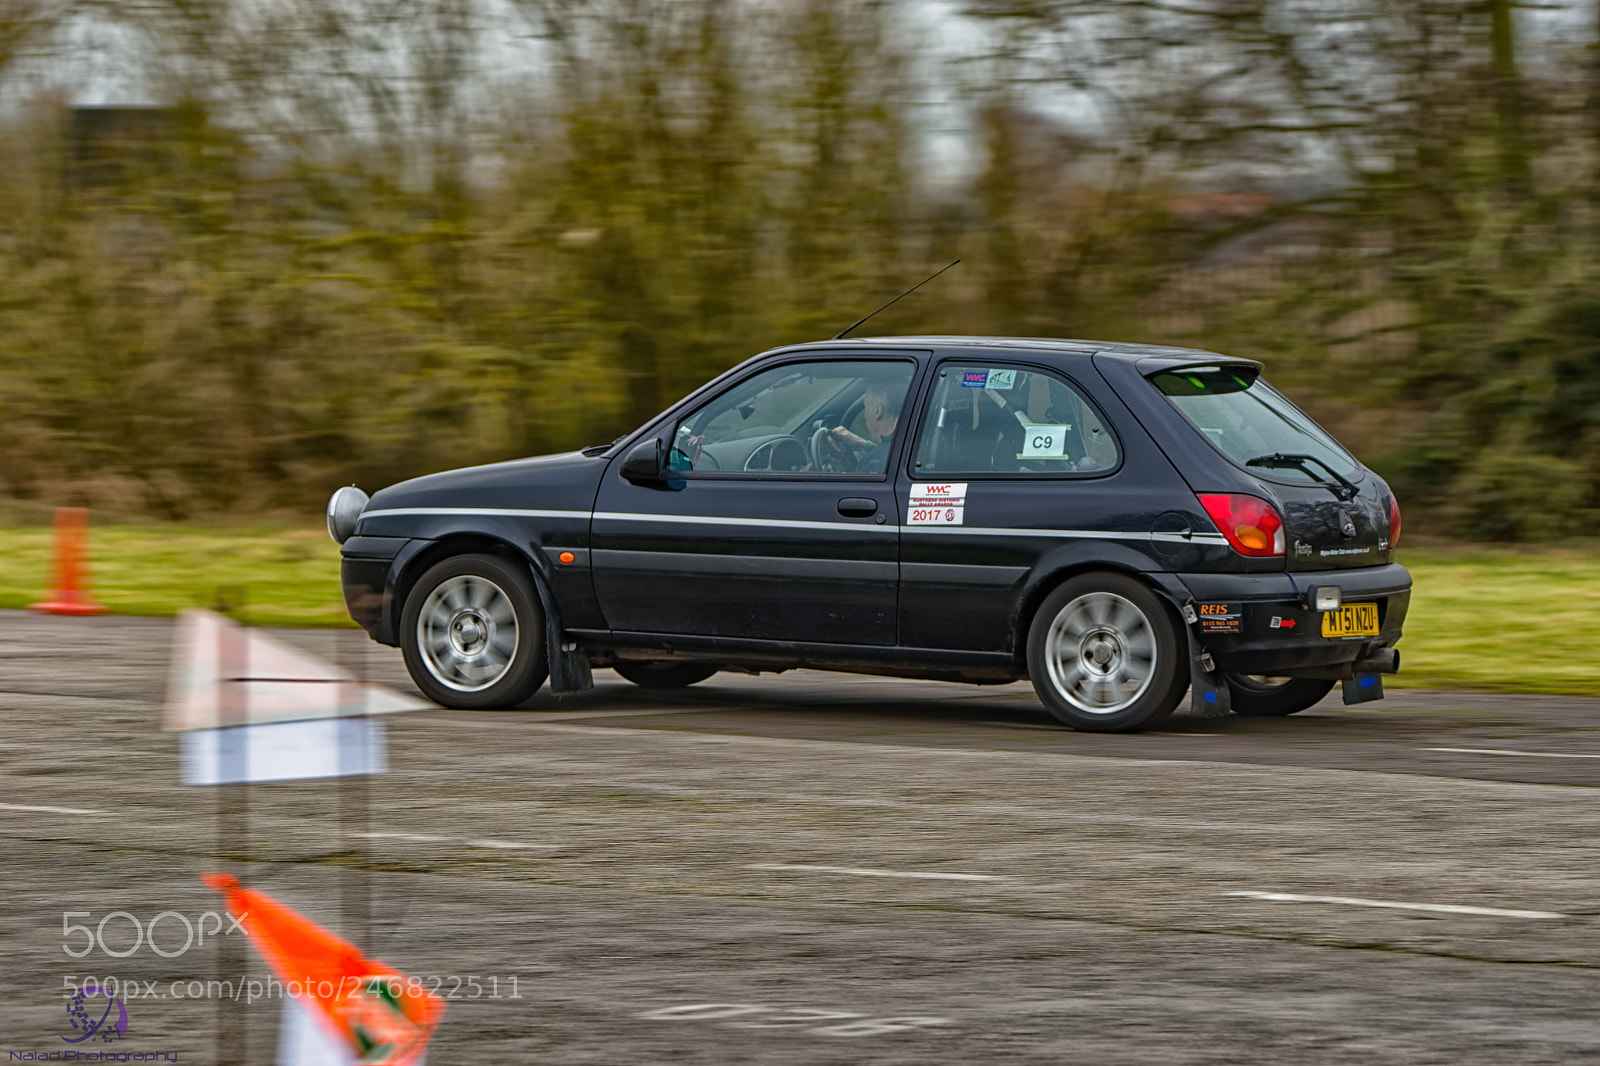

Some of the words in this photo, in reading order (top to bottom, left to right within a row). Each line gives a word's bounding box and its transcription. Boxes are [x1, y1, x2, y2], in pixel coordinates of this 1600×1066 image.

[1032, 435, 1053, 449] C9
[926, 485, 952, 493] WMC
[912, 509, 941, 521] 2017
[1200, 604, 1228, 615] REIS
[1355, 606, 1374, 631] NZU
